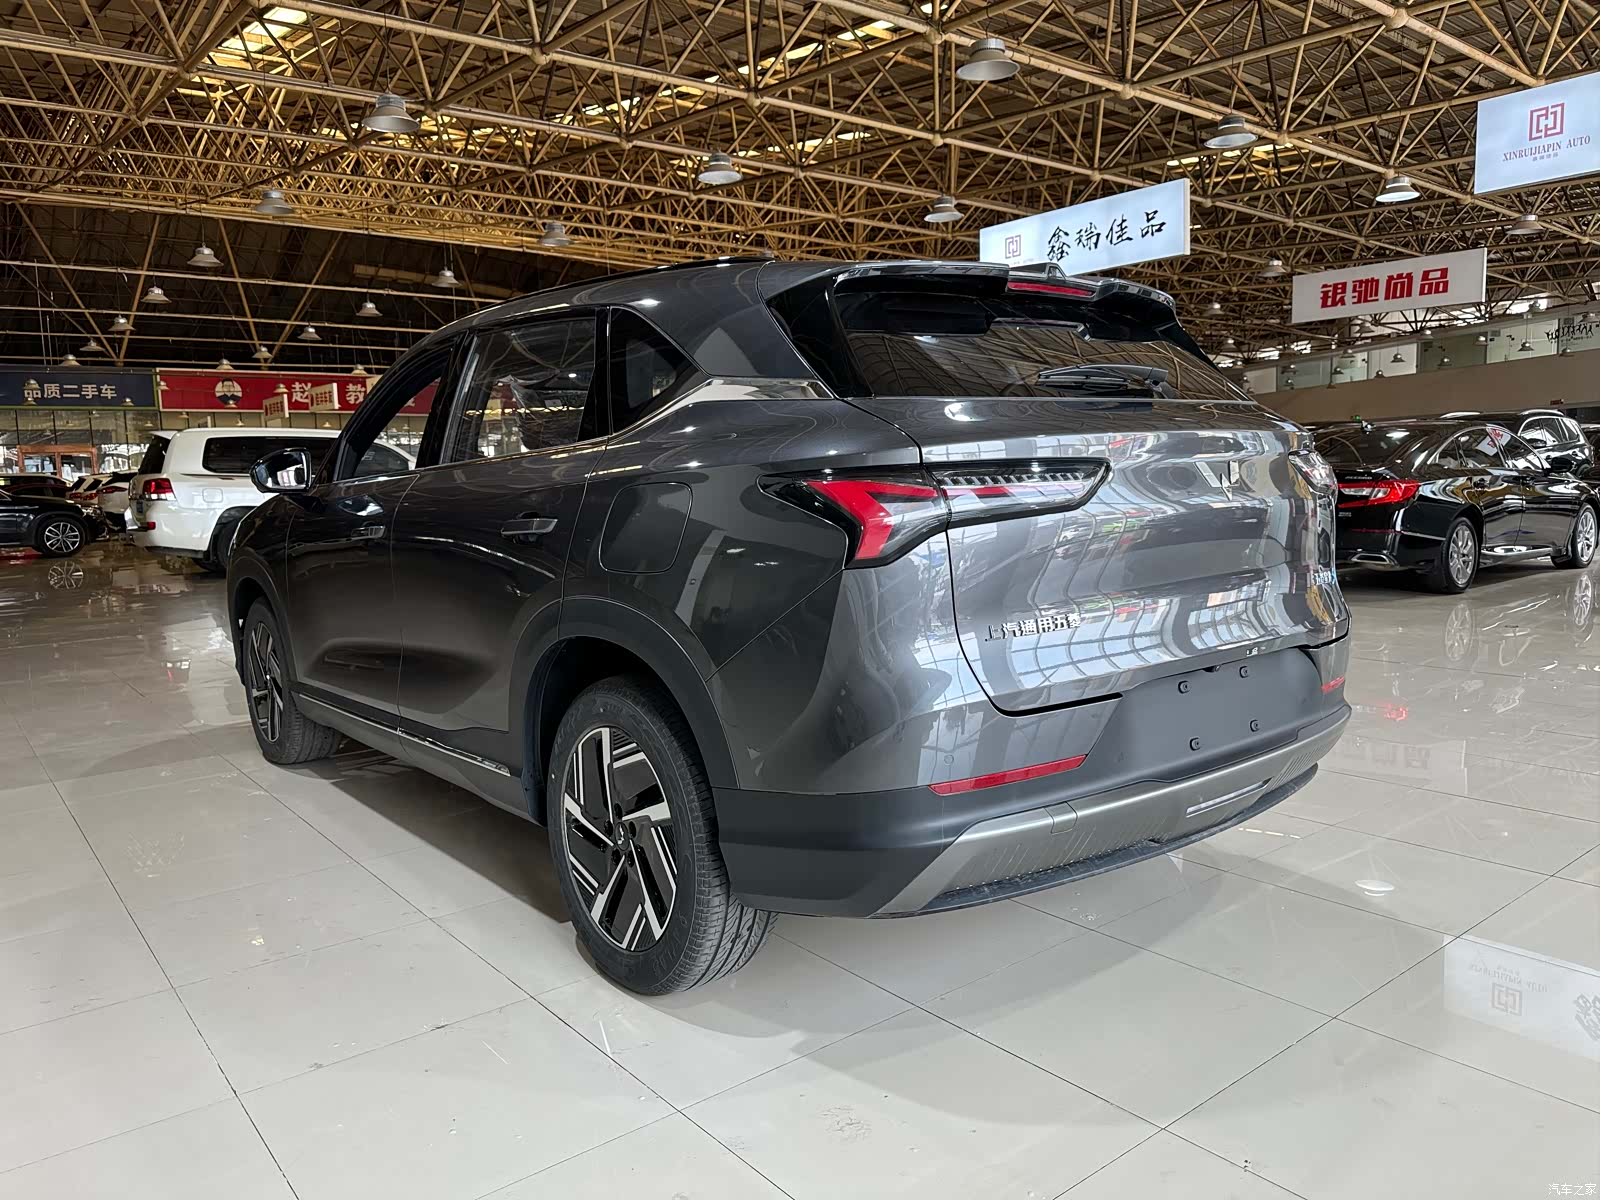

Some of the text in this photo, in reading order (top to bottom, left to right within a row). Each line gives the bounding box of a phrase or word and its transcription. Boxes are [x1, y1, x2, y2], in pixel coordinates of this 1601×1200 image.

[1502, 140, 1562, 162] XINRUIJIAPIN
[1566, 135, 1591, 149] AUTO
[1047, 209, 1167, 262] 鑫瑞佳品
[1320, 267, 1450, 309] 银驰尚品
[24, 383, 117, 400] 品质二手车
[985, 612, 1081, 642] 上汽通用五菱
